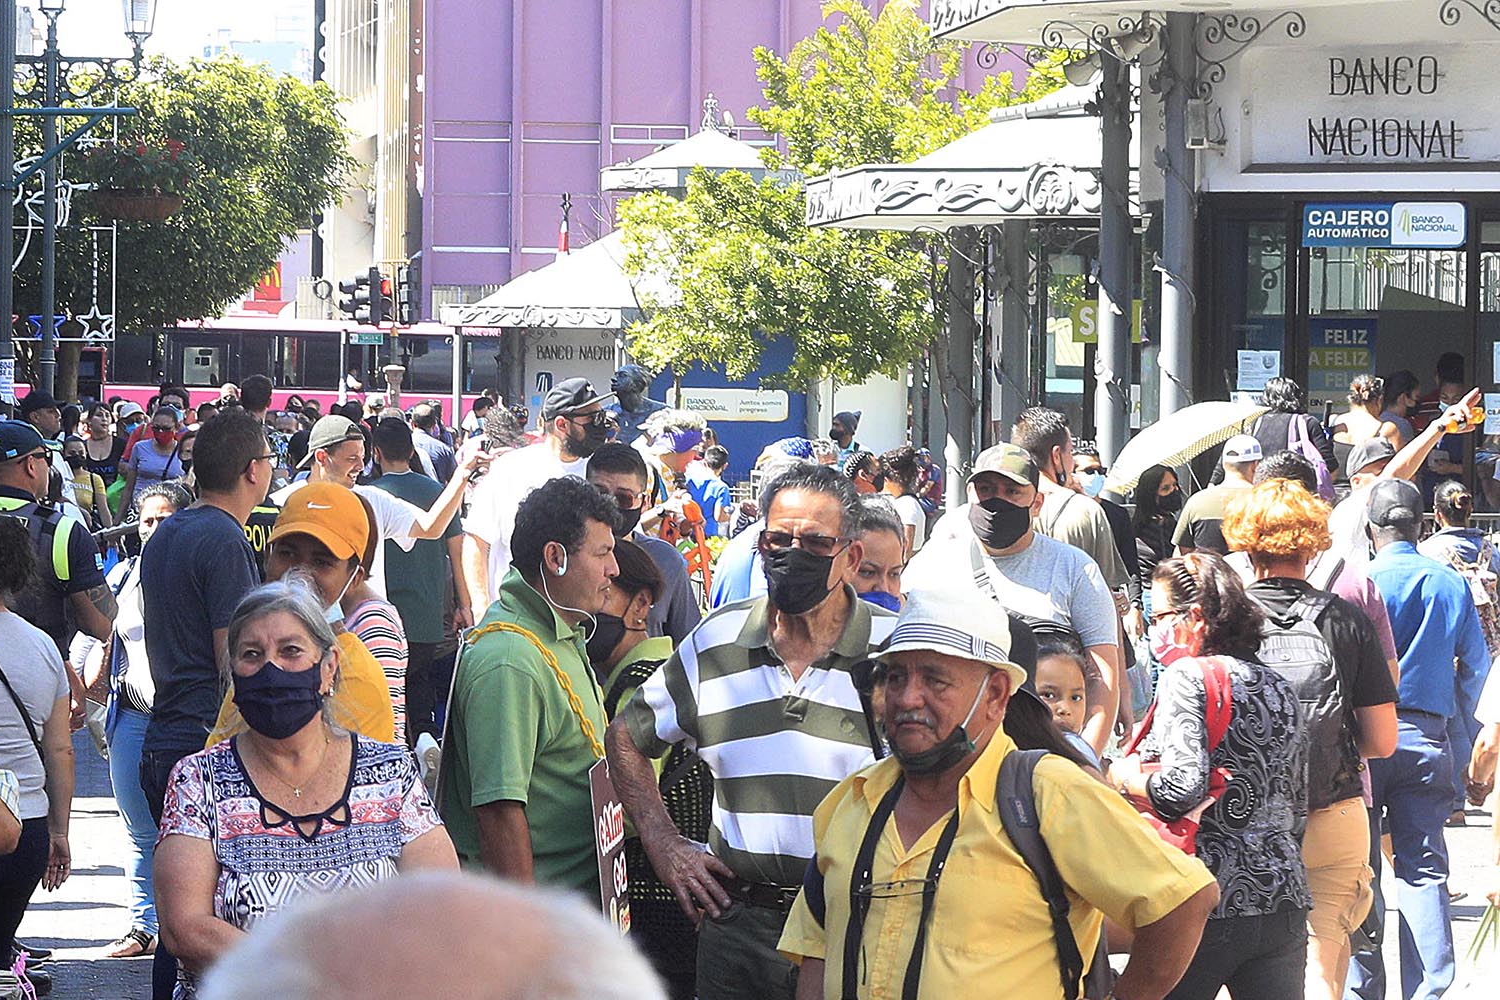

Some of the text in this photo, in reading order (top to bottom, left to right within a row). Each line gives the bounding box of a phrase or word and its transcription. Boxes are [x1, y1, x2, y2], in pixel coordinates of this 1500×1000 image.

[1329, 56, 1438, 96] BANCO
[1308, 117, 1470, 160] NACIONAL
[1308, 210, 1389, 226] CAJERO
[1307, 227, 1389, 239] AUTOMÁTICO
[1411, 223, 1458, 232] NACIONAL
[1324, 328, 1368, 345] FELIZ
[536, 344, 573, 361] BANCO
[1324, 351, 1368, 367] FELIZ
